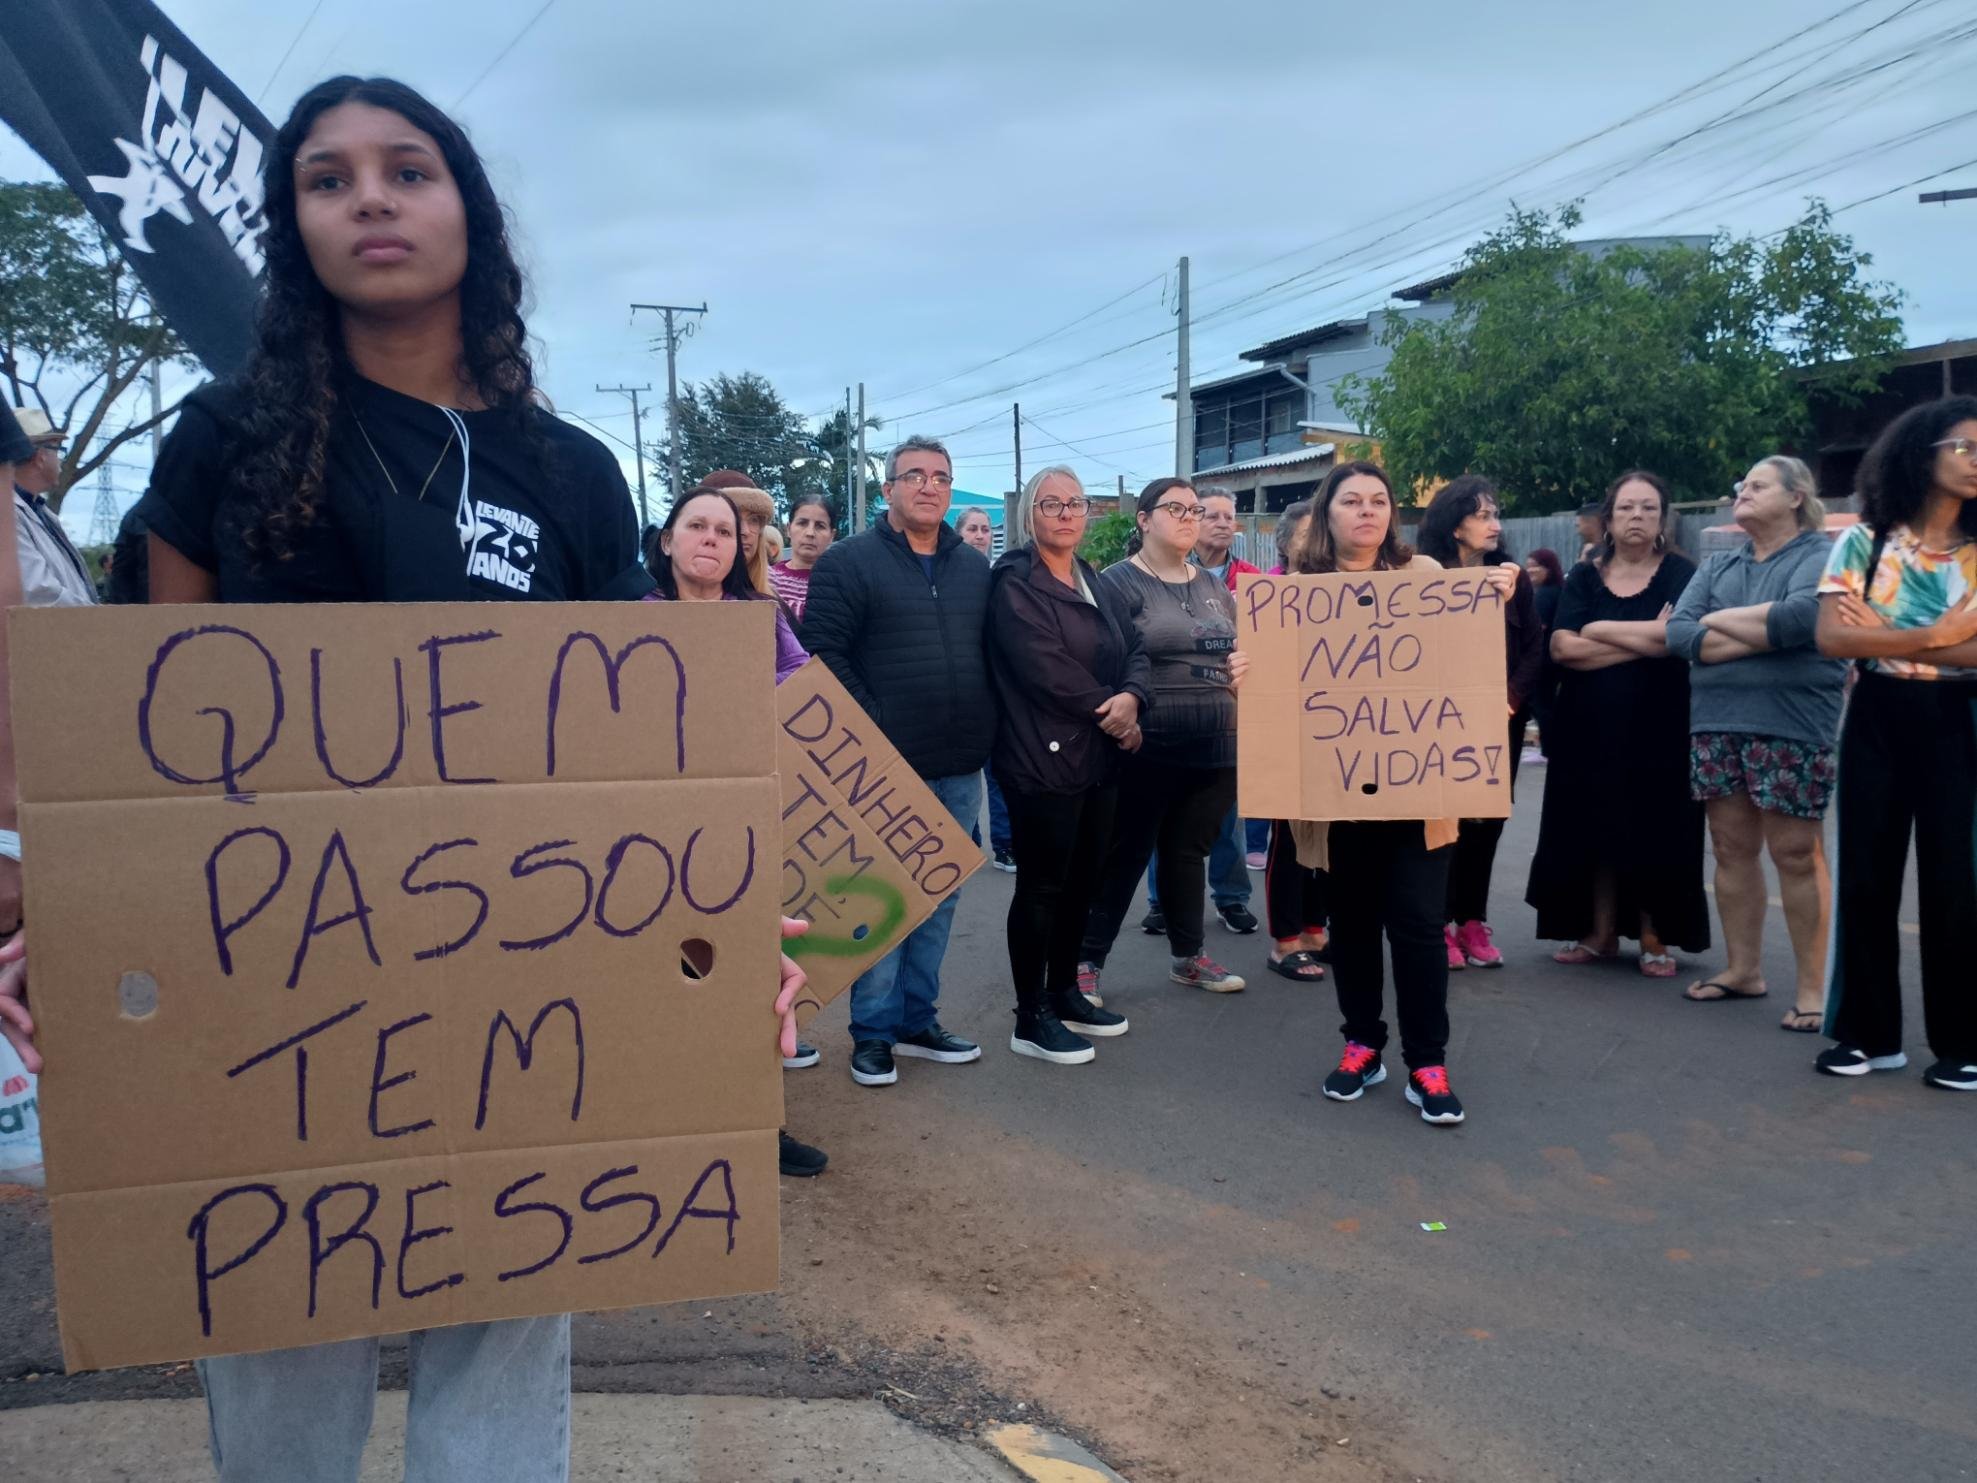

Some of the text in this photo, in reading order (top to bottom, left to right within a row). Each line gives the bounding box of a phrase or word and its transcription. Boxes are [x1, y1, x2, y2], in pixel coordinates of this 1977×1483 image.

[476, 500, 540, 540] LEVANTE
[472, 552, 530, 593] ANOS
[1246, 579, 1499, 632] PROMESSA
[1205, 640, 1233, 650] DREA
[1301, 621, 1422, 682] NÃO
[138, 624, 686, 804] QUEM
[1304, 691, 1464, 741] SALVA
[1335, 742, 1502, 792] VIDAS!
[205, 826, 755, 989] PASSOU
[227, 998, 586, 1142] TEM
[188, 1159, 741, 1337] PRESSA
